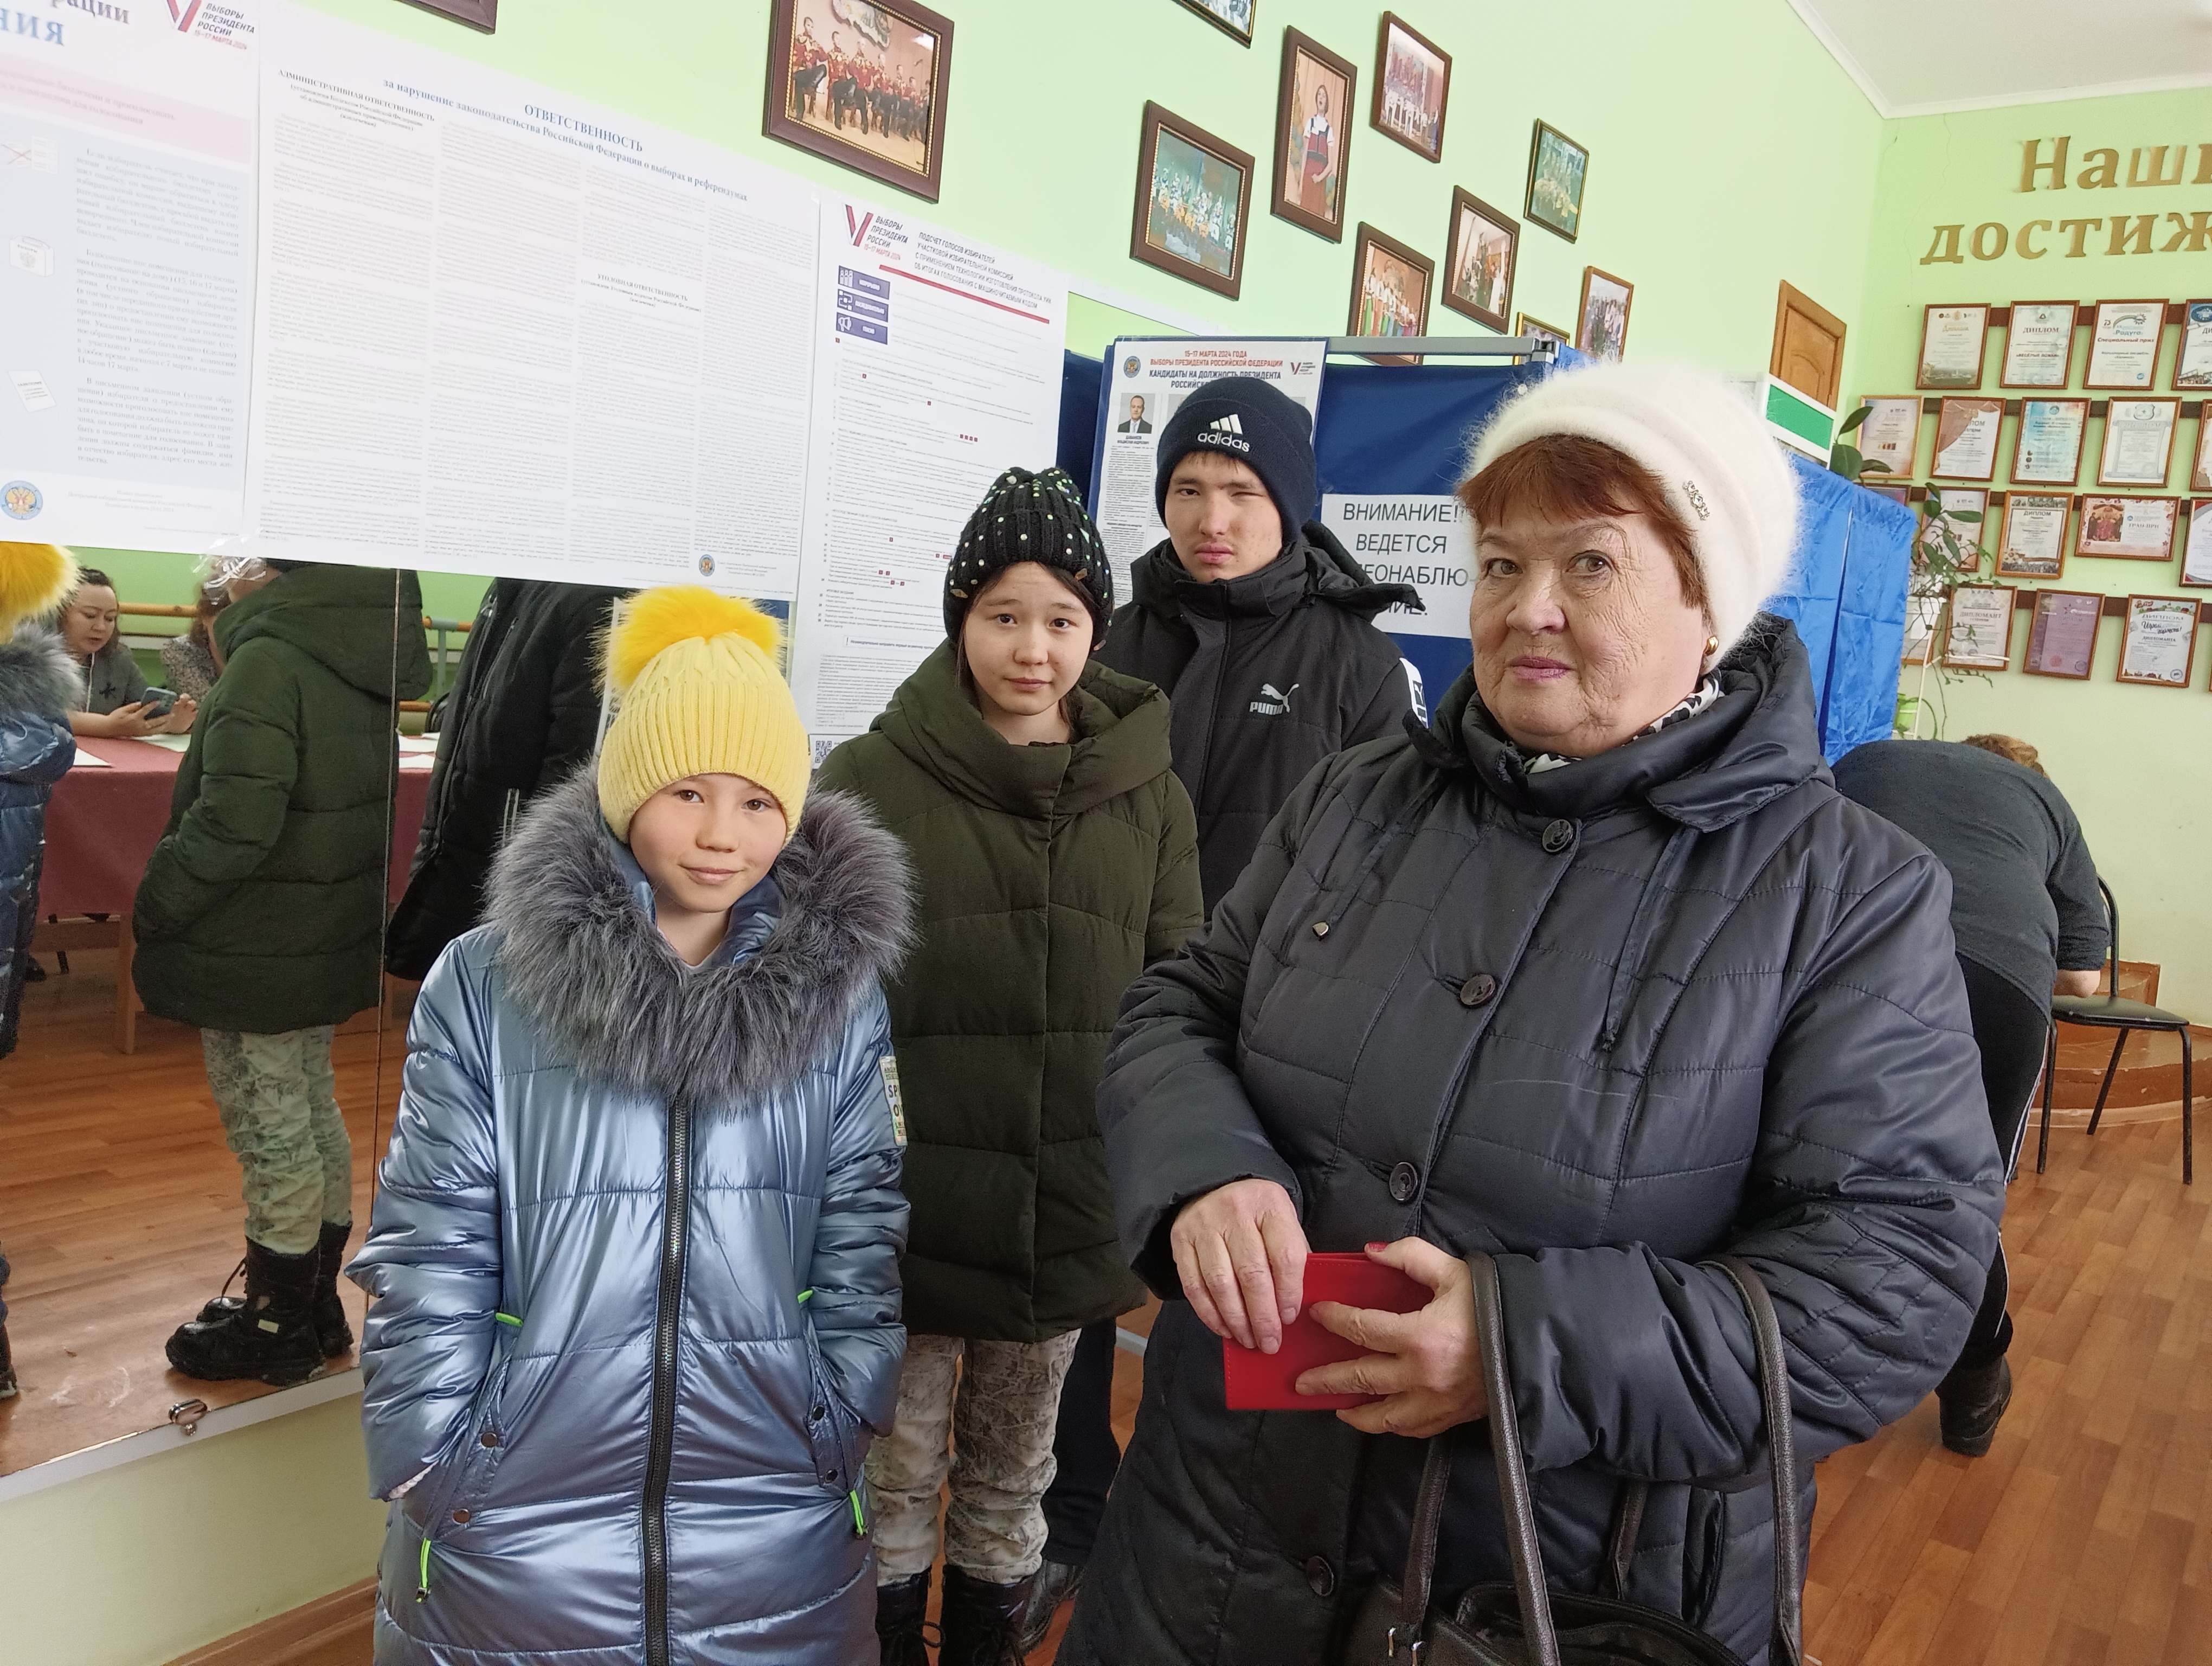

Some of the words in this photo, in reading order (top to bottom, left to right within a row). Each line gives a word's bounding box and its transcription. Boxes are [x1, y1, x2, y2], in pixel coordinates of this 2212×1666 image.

[207, 3, 244, 20] ВЫБОРЫ
[198, 21, 232, 36] РОССИИ
[202, 12, 255, 34] ПРЕЗИДЕНТА
[212, 36, 232, 46] МАРТА
[278, 69, 363, 100] АДМИНИСТРАТИВНАЯ
[364, 95, 435, 121] ОТВЕТСТВЕННОСТЬ
[524, 104, 642, 152] ОТВЕТСТВЕННОСТЬ
[383, 79, 394, 89] за
[396, 83, 454, 107] нарушение
[456, 102, 541, 134] законодательства
[542, 126, 594, 151] Российской
[595, 144, 642, 167] Федерации
[651, 164, 685, 181] выборах
[693, 178, 748, 202] референдумах
[876, 216, 903, 230] ВЫБОРЫ
[867, 235, 891, 248] РОССИИ
[871, 226, 909, 244] ПРЕЗИДЕНТА
[876, 248, 891, 258] МАРТА
[918, 231, 942, 245] ПОДСЧЕТ
[941, 239, 964, 253] ГОЛОСОВ
[963, 248, 995, 264] ИЗБИРАТЕЛЕЙ
[917, 241, 949, 258] УЧАСТКОВОЙ
[948, 253, 987, 271] ИЗБИРАТЕЛЬНОЙ
[987, 267, 1014, 281] КОМИССИЕЙ
[914, 261, 921, 270] ОБ
[921, 264, 940, 276] ИТОГАХ
[940, 270, 974, 287] ГОЛОСОВАНИЯ
[978, 283, 1022, 303] МАШИНОЧИТАЕМЫМ
[1021, 299, 1038, 309] КОДОМ
[915, 251, 919, 259] С
[918, 253, 955, 271] ПРИМЕНЕНИЕМ
[955, 265, 985, 280] ТЕХНОЛОГИИ
[985, 276, 1018, 292] ИЗГОТОВЛЕНИЯ
[1018, 287, 1043, 301] ПРОТОКОЛА
[1210, 358, 1246, 367] РОССИЙСКОЙ
[1149, 370, 1187, 378] КАНДИДАТЫ
[1197, 432, 1251, 452] adidas
[1356, 534, 1447, 555] ВЕДЕТСЯ
[1249, 701, 1283, 715] PUMA
